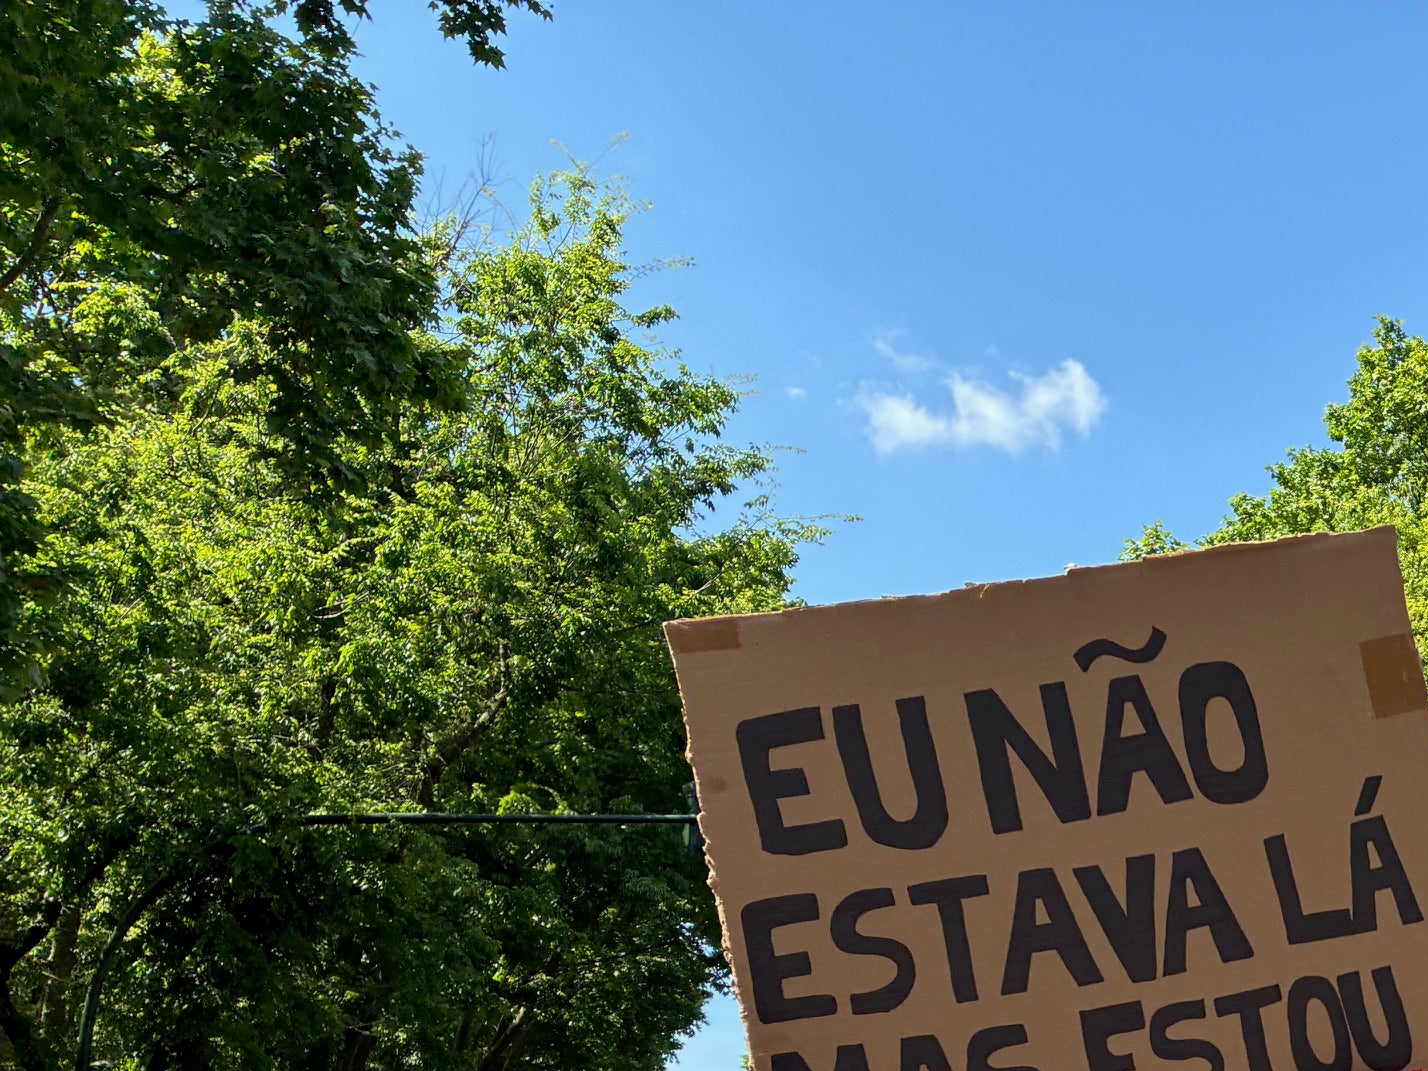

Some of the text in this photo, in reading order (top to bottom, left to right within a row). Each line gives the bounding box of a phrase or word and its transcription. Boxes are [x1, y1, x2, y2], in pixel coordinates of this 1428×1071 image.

[735, 626, 1270, 857] EU NÃO
[740, 775, 1424, 1025] ESTAVA LÁ
